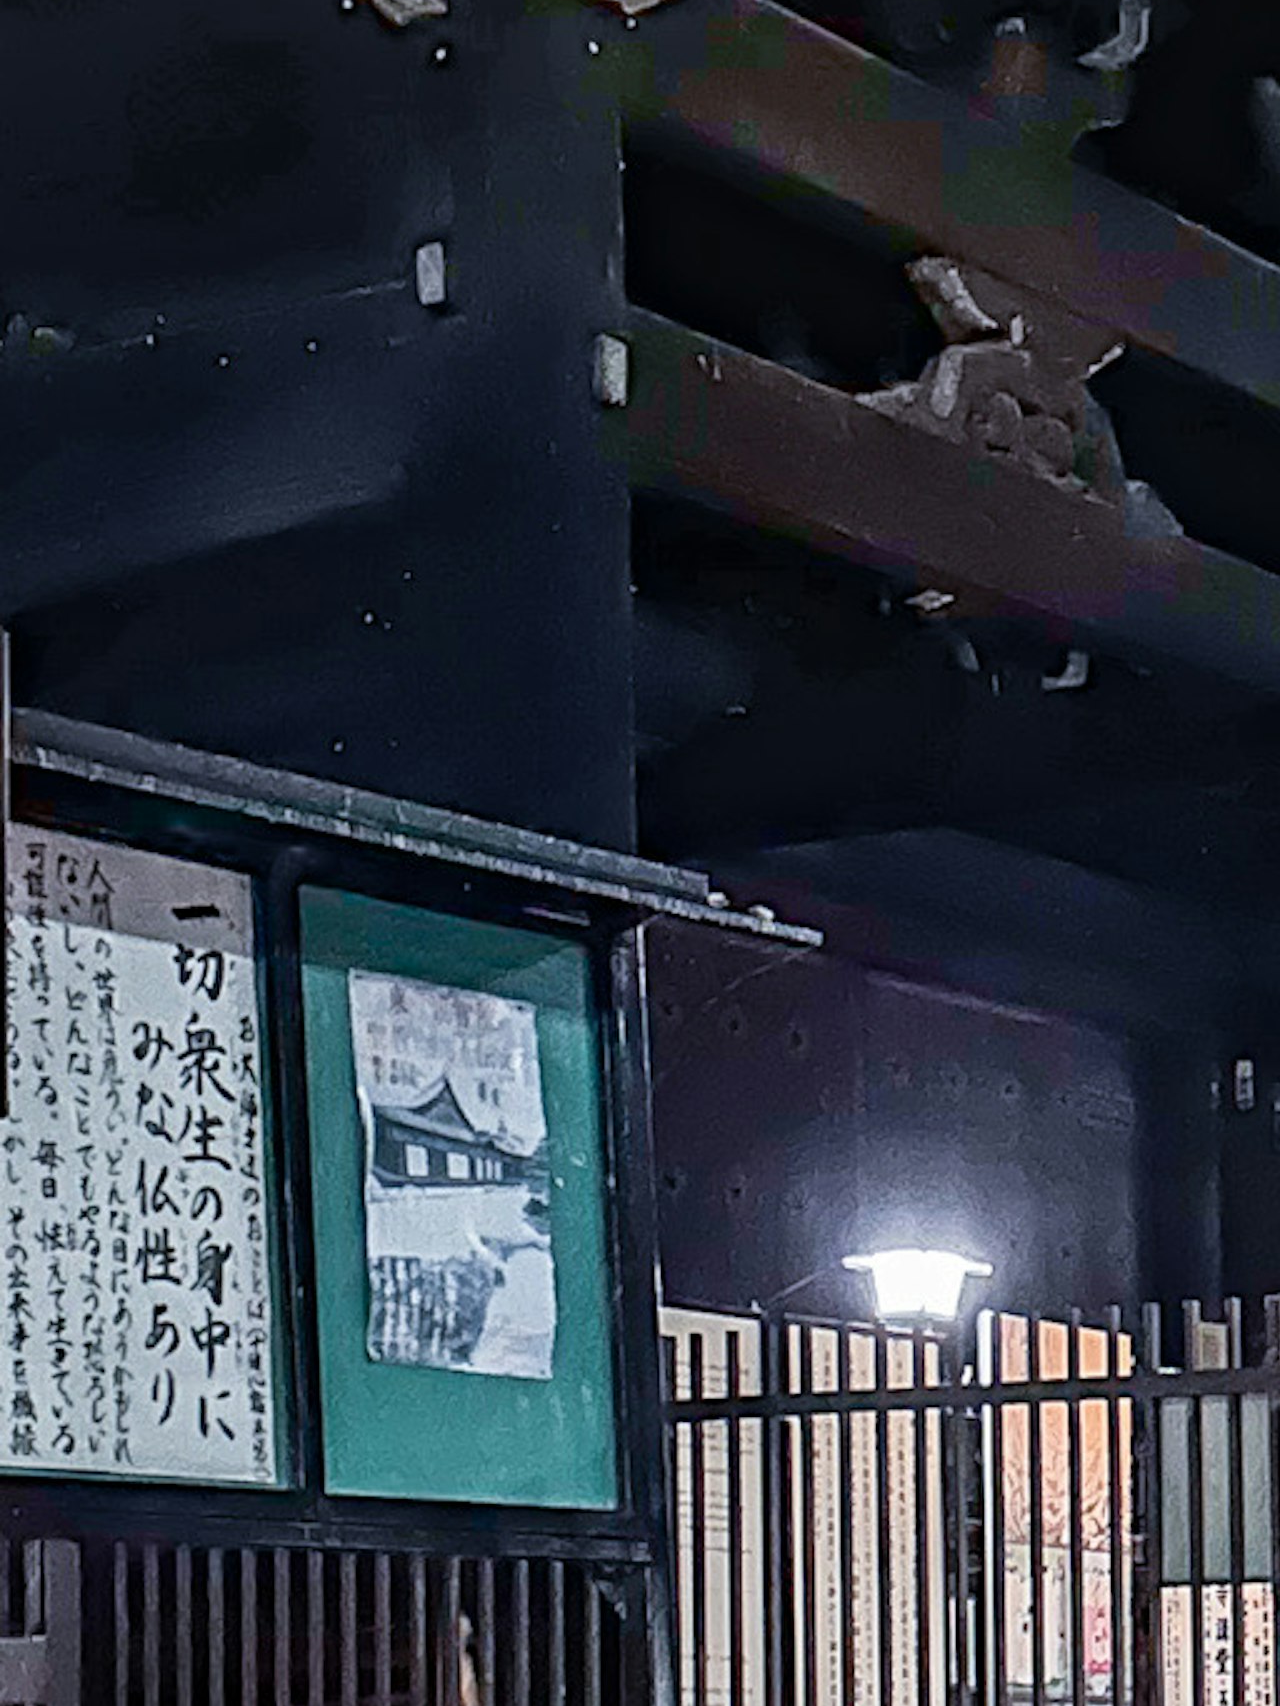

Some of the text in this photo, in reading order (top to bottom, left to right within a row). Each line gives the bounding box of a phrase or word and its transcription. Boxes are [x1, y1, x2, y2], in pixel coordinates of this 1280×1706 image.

[132, 1022, 182, 1425] みな仏性あり
[172, 904, 236, 1440] 一切衆生の身中に
